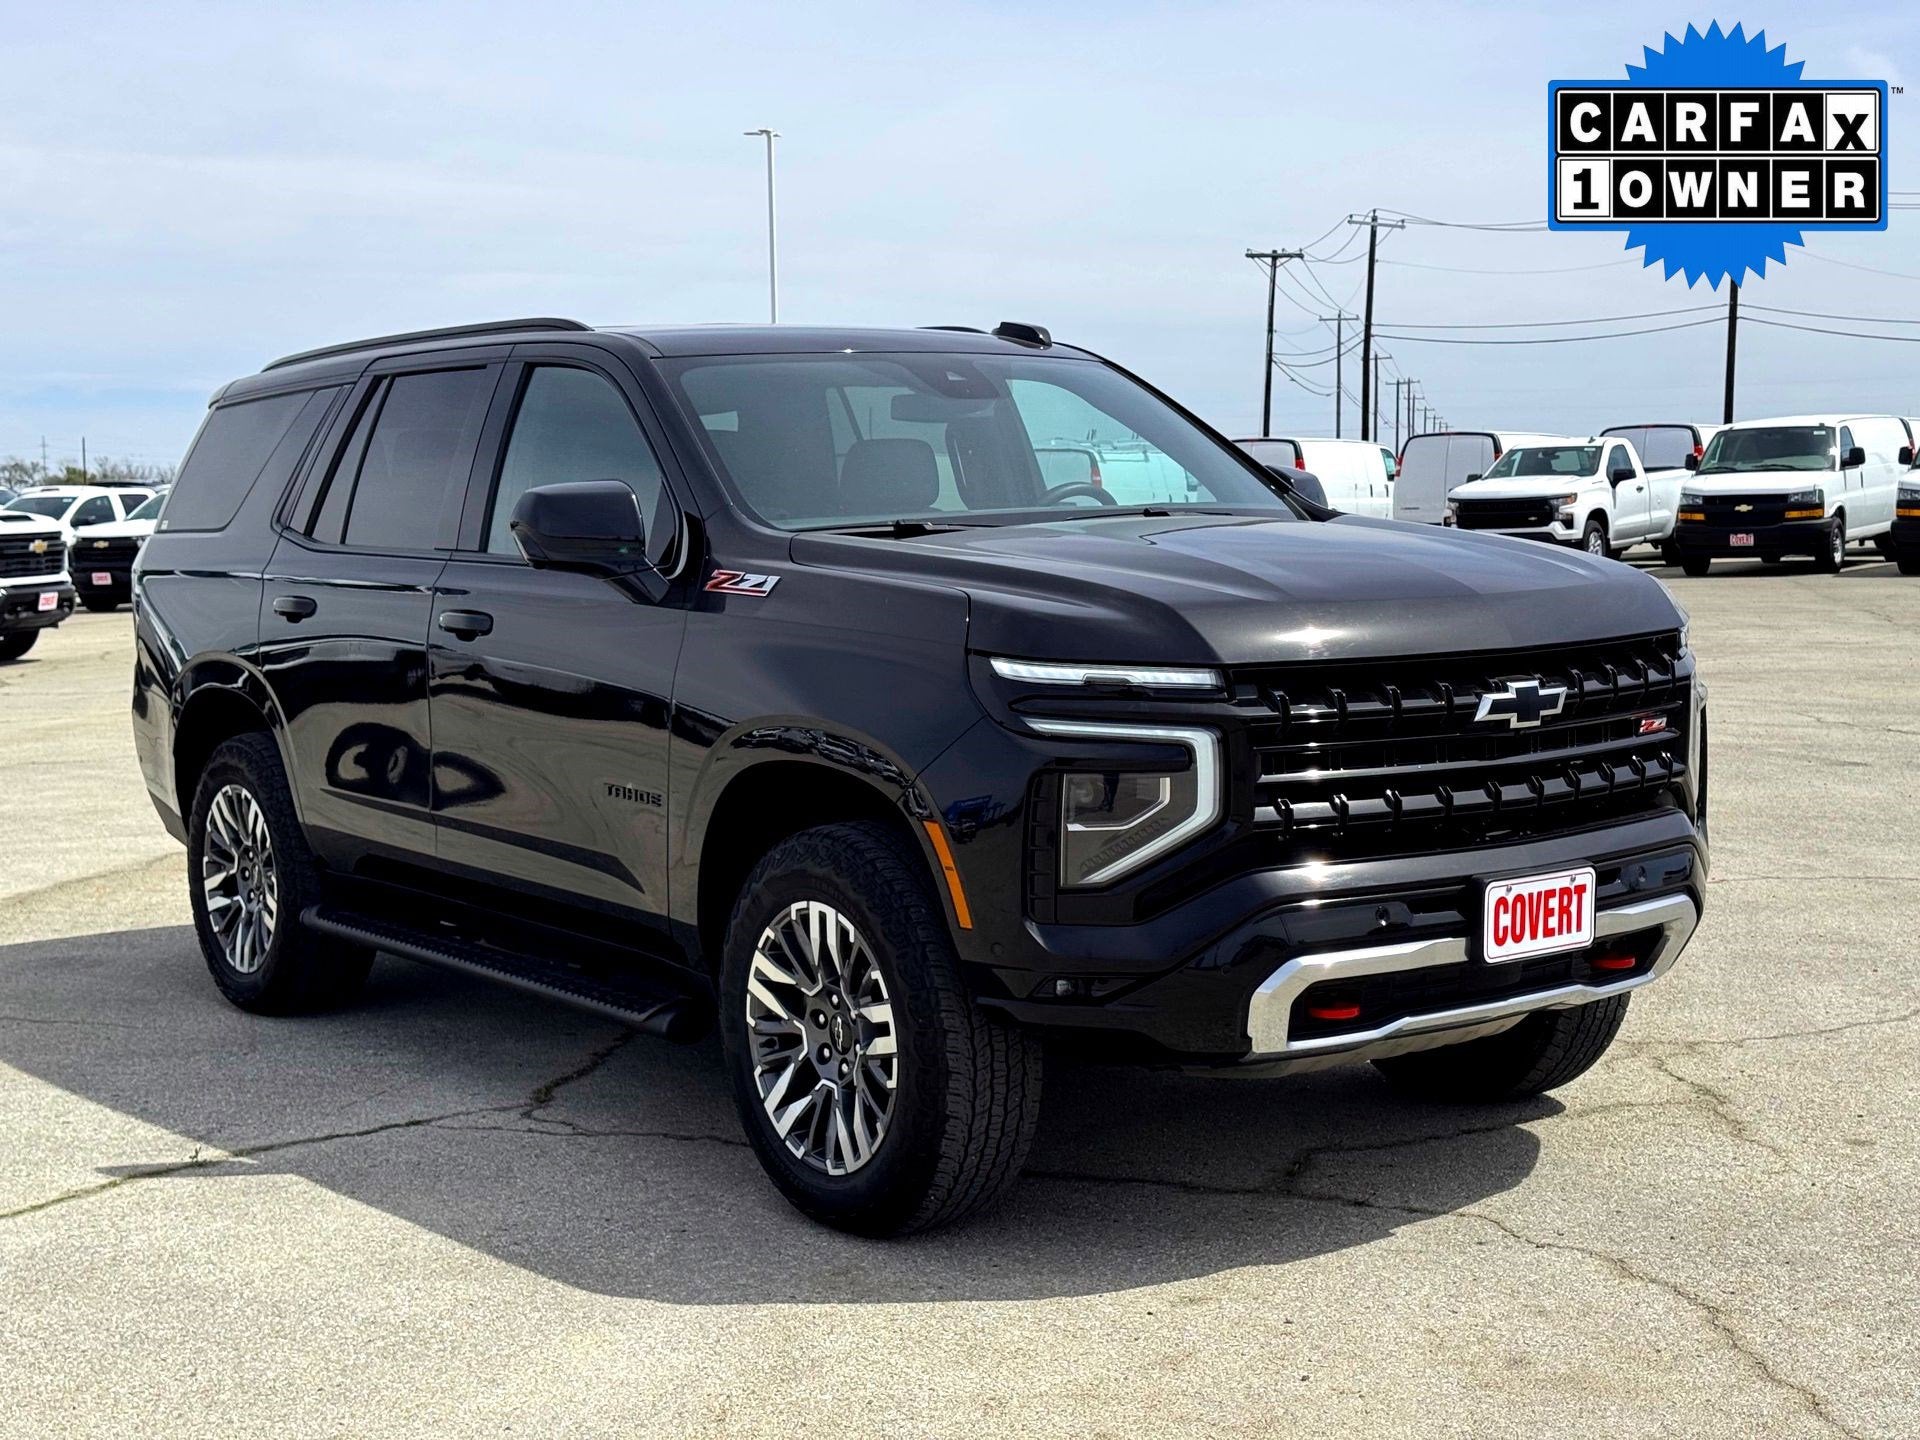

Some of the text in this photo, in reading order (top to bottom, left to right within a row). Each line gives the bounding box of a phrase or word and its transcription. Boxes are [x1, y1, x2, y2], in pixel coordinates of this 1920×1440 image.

[704, 569, 780, 597] Z71
[604, 784, 662, 807] TAHOE
[1494, 884, 1587, 947] COVERT
